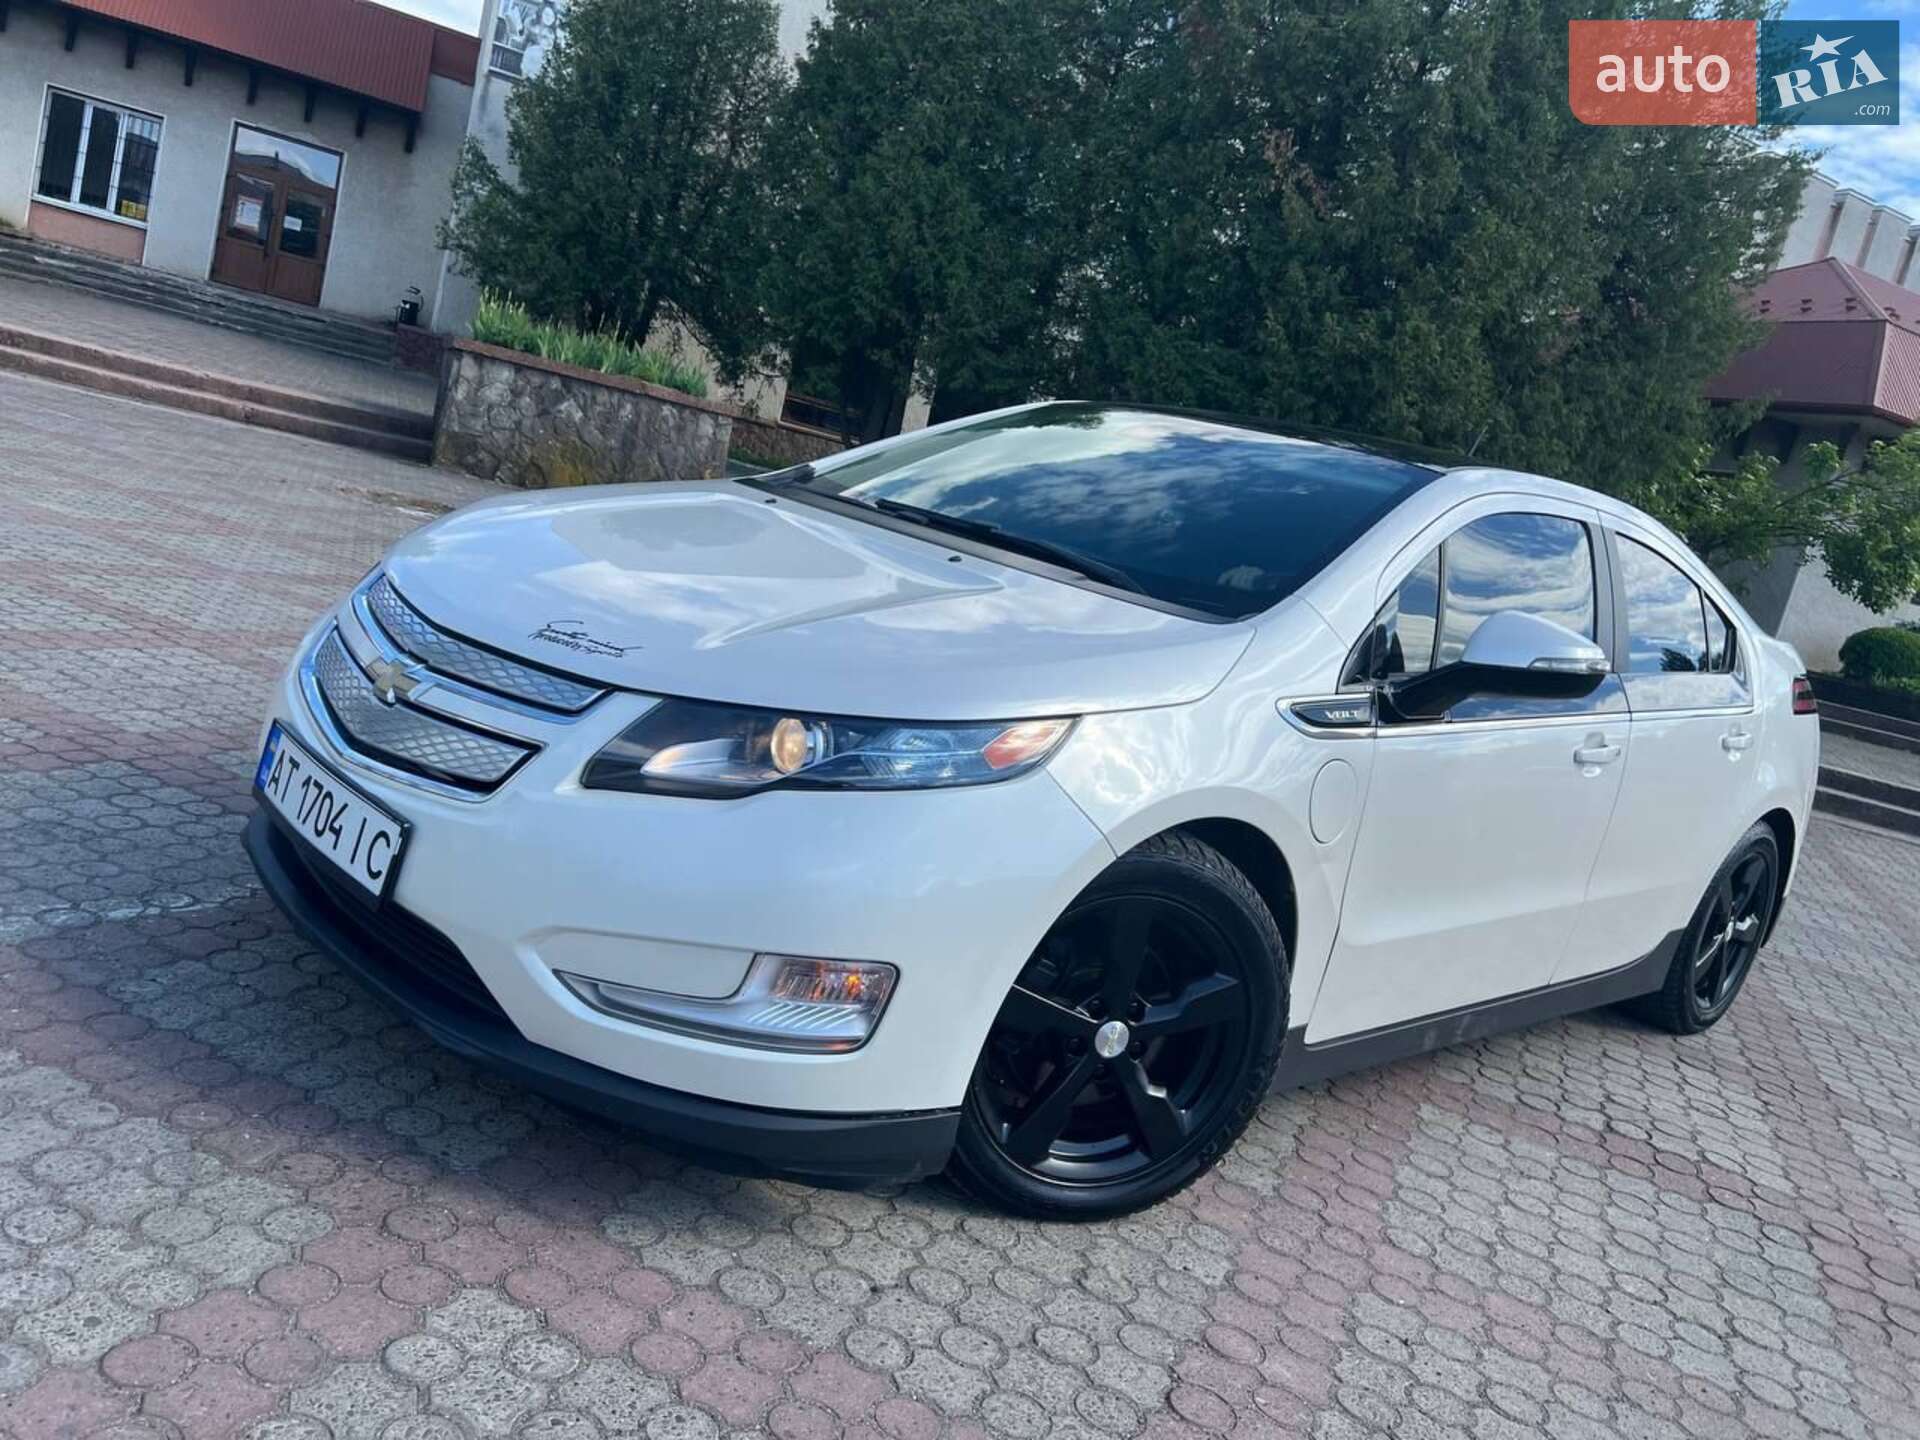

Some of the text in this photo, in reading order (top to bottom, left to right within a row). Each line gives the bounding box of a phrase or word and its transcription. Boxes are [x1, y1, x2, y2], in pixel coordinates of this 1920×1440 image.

[1324, 710, 1359, 719] VOLT
[267, 749, 391, 880] AT 1704 IC
